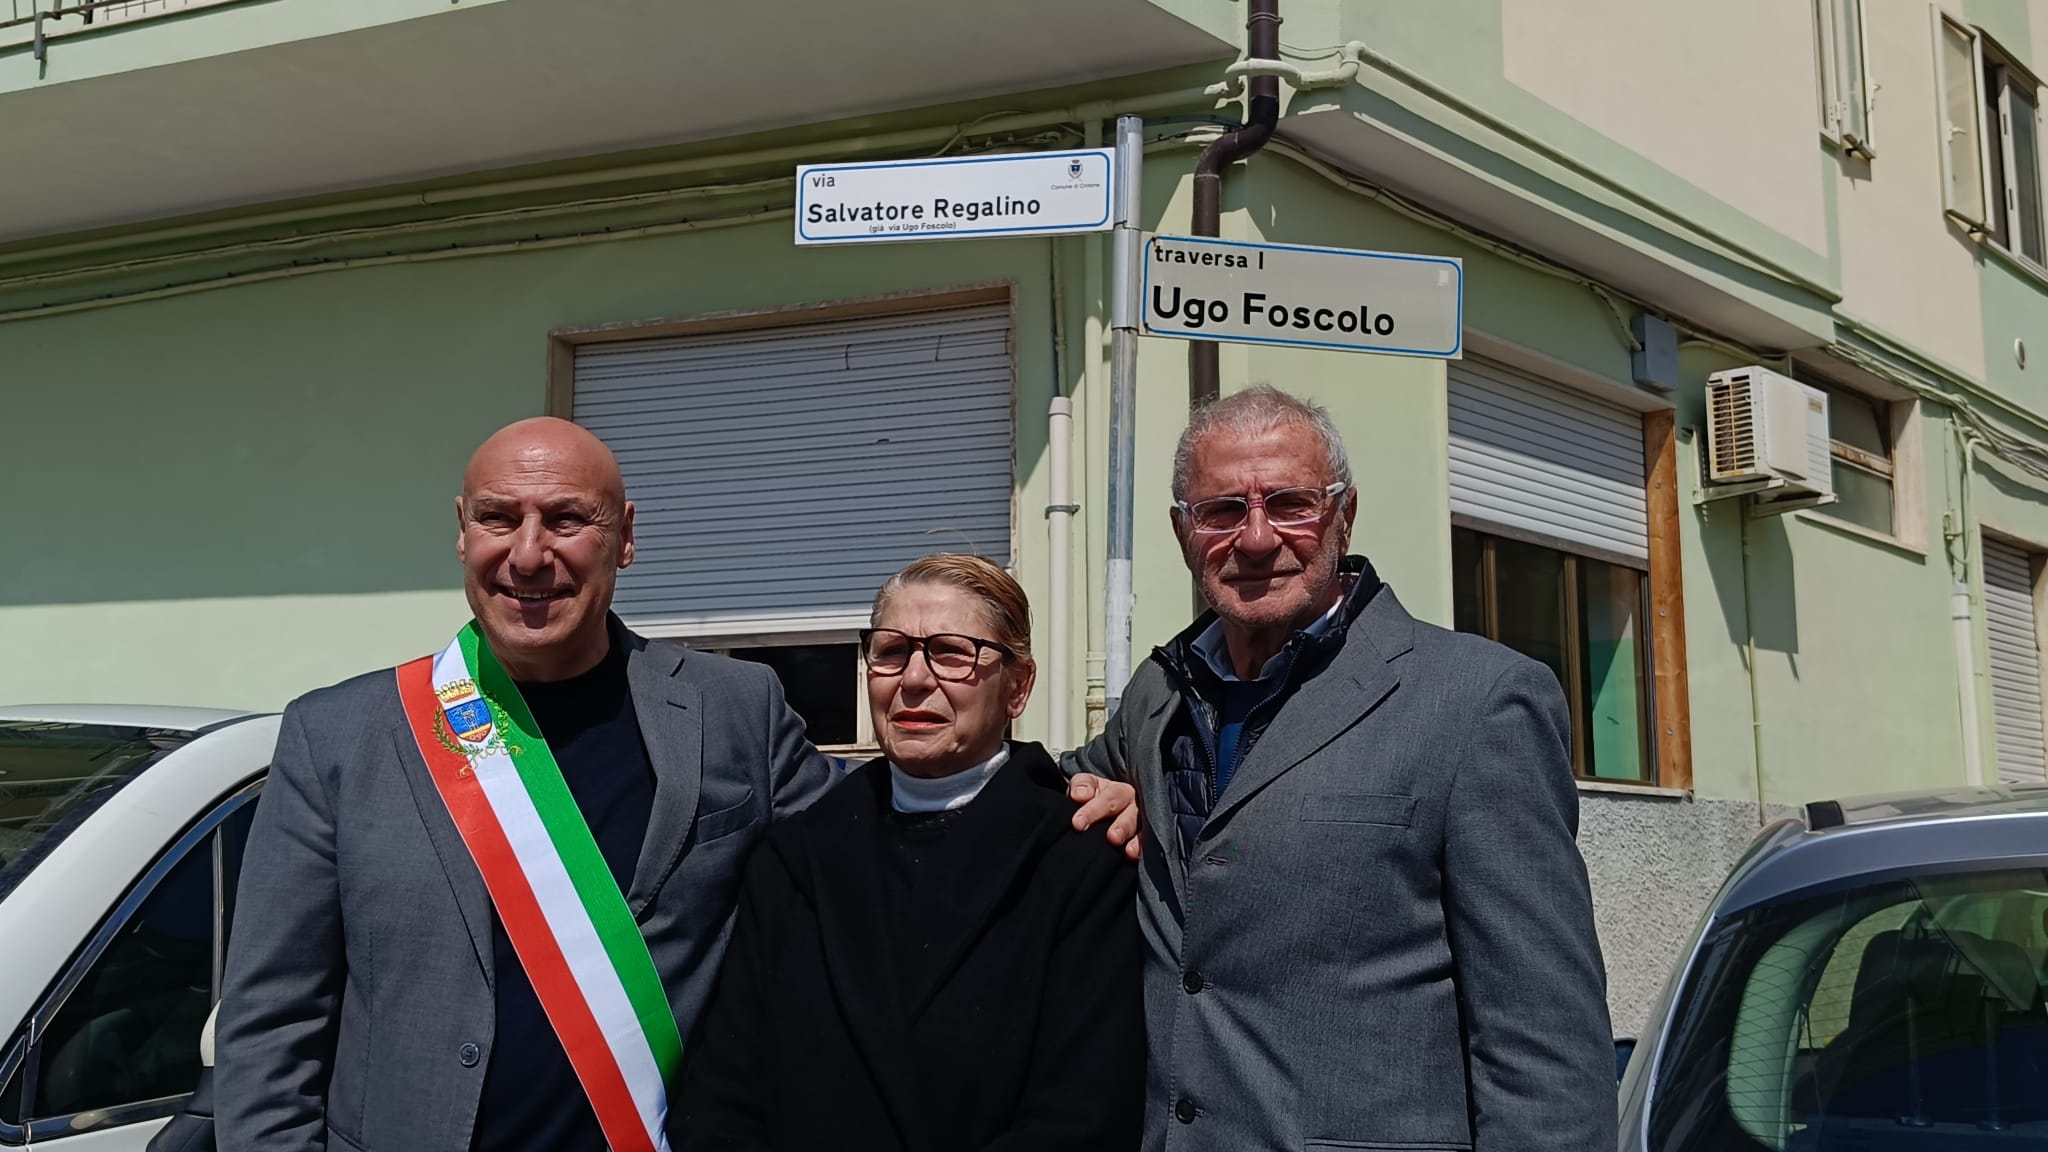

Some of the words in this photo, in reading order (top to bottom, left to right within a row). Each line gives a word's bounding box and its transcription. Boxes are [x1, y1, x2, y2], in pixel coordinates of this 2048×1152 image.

[812, 173, 836, 188] via
[807, 201, 924, 224] Salvatore
[934, 196, 1041, 222] Regalino
[902, 223, 919, 231] Ugo
[921, 221, 956, 230] Foscolo)
[1154, 246, 1249, 268] traversa
[1152, 285, 1229, 328] Ugo
[1243, 292, 1395, 336] Foscolo
